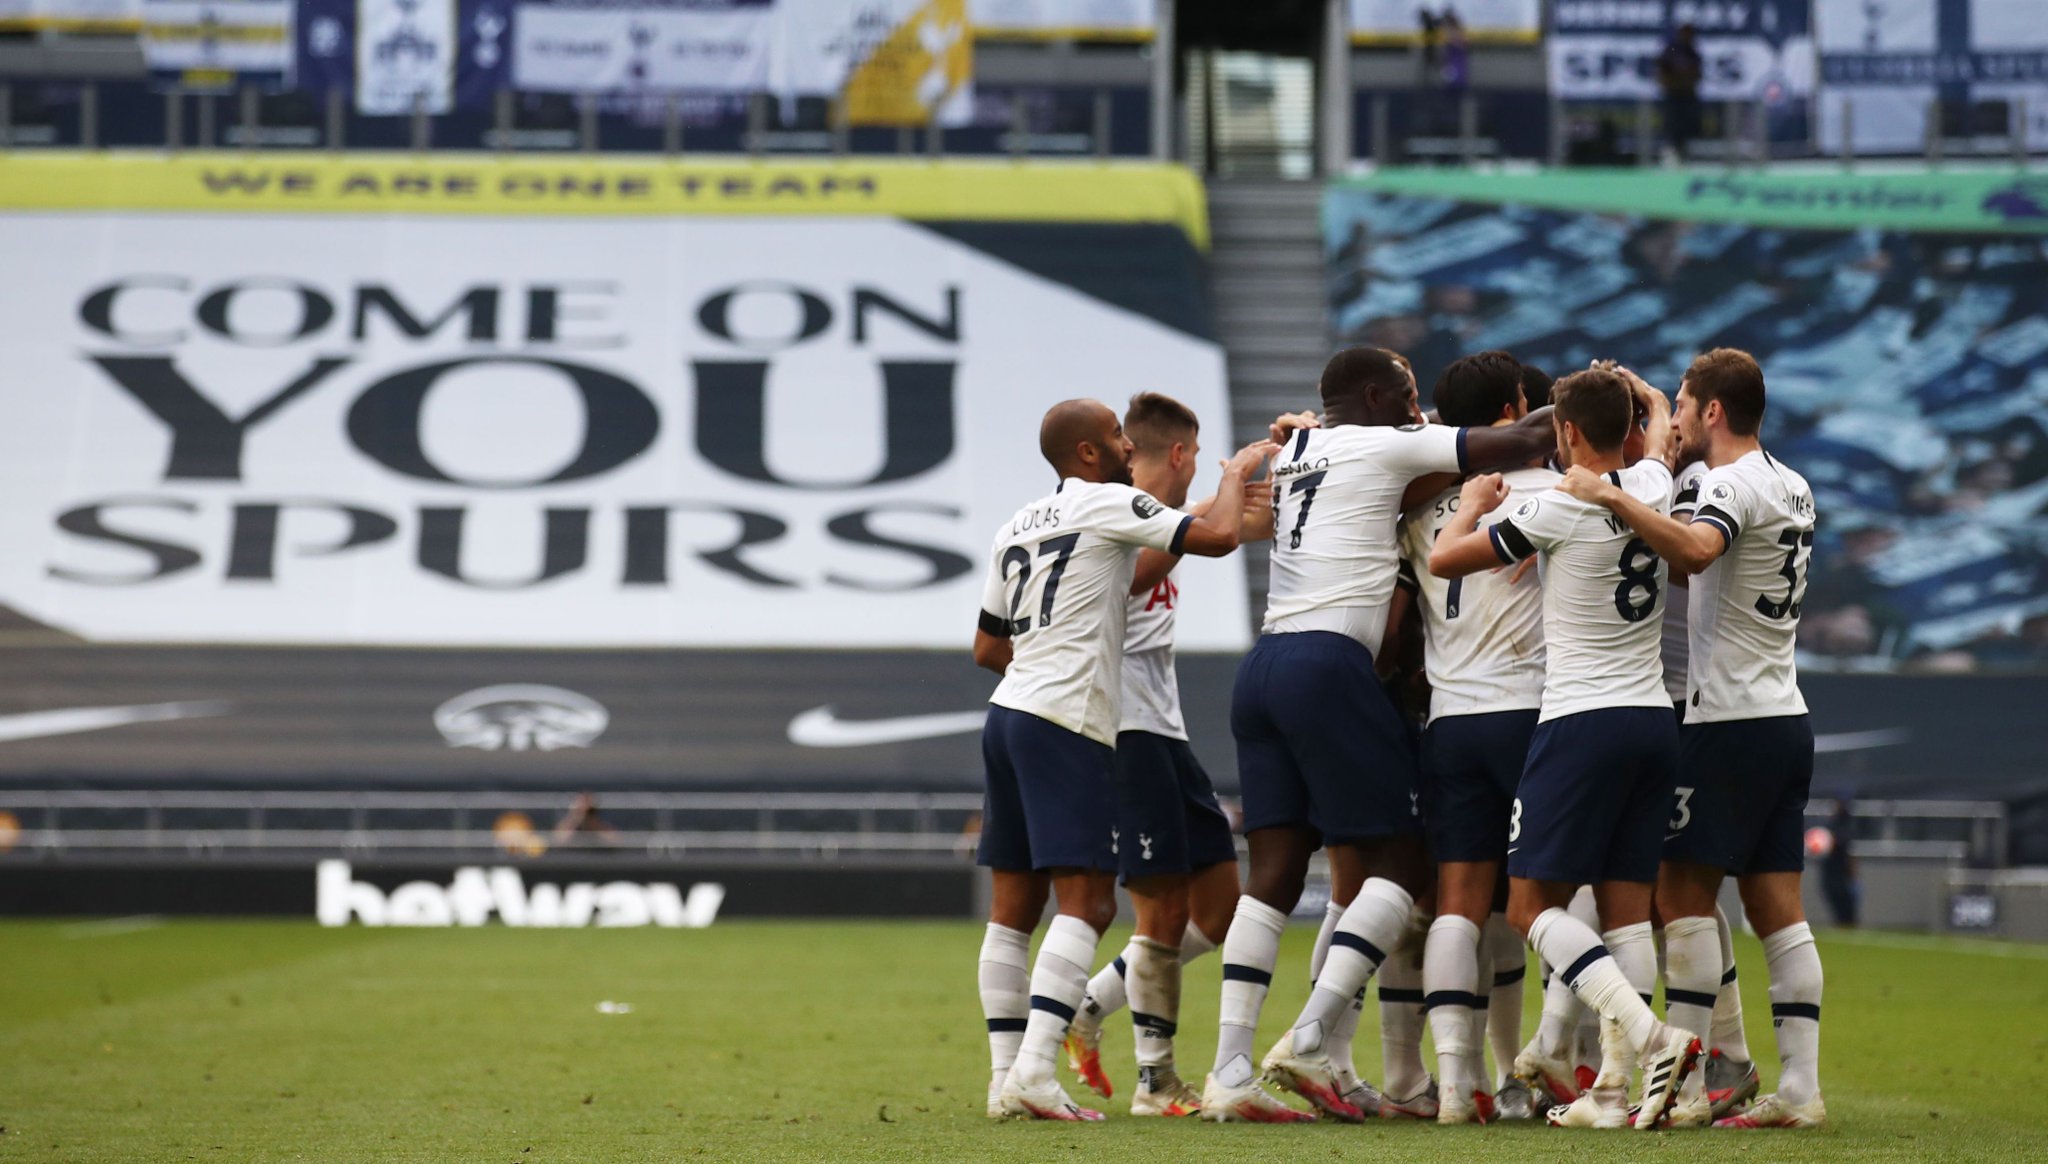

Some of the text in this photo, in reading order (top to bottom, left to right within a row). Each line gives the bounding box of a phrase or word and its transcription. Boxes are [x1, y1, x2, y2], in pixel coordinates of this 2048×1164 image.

[1562, 53, 1746, 83] SPS
[202, 170, 878, 199] WE ARE ONE TEAM
[78, 275, 964, 348] COME ON
[78, 353, 961, 491] YOU
[46, 496, 976, 592] SPURS
[1012, 506, 1061, 536] LUCAS
[1001, 532, 1081, 636] 27
[1615, 537, 1659, 623] 8
[1669, 787, 1695, 830] 3
